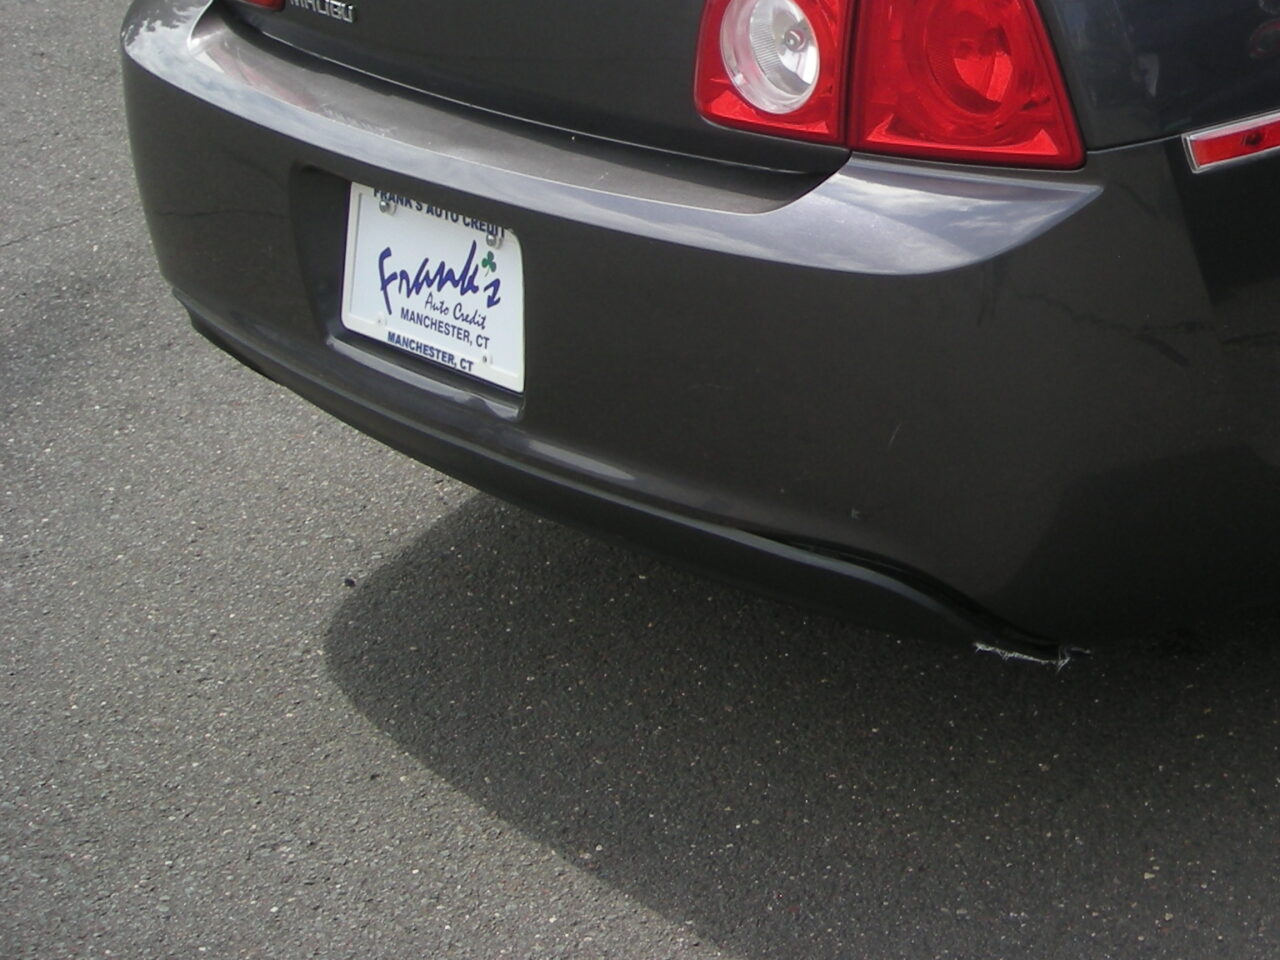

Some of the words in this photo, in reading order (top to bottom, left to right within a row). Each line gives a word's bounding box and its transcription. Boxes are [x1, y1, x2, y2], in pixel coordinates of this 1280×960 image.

[426, 205, 460, 223] AUTO
[462, 215, 505, 239] CREDIT
[424, 292, 450, 316] Auto
[400, 307, 473, 347] MANCHESTER,
[475, 334, 490, 350] CT
[387, 331, 457, 368] MANCHESTER,
[459, 358, 475, 372] CT
